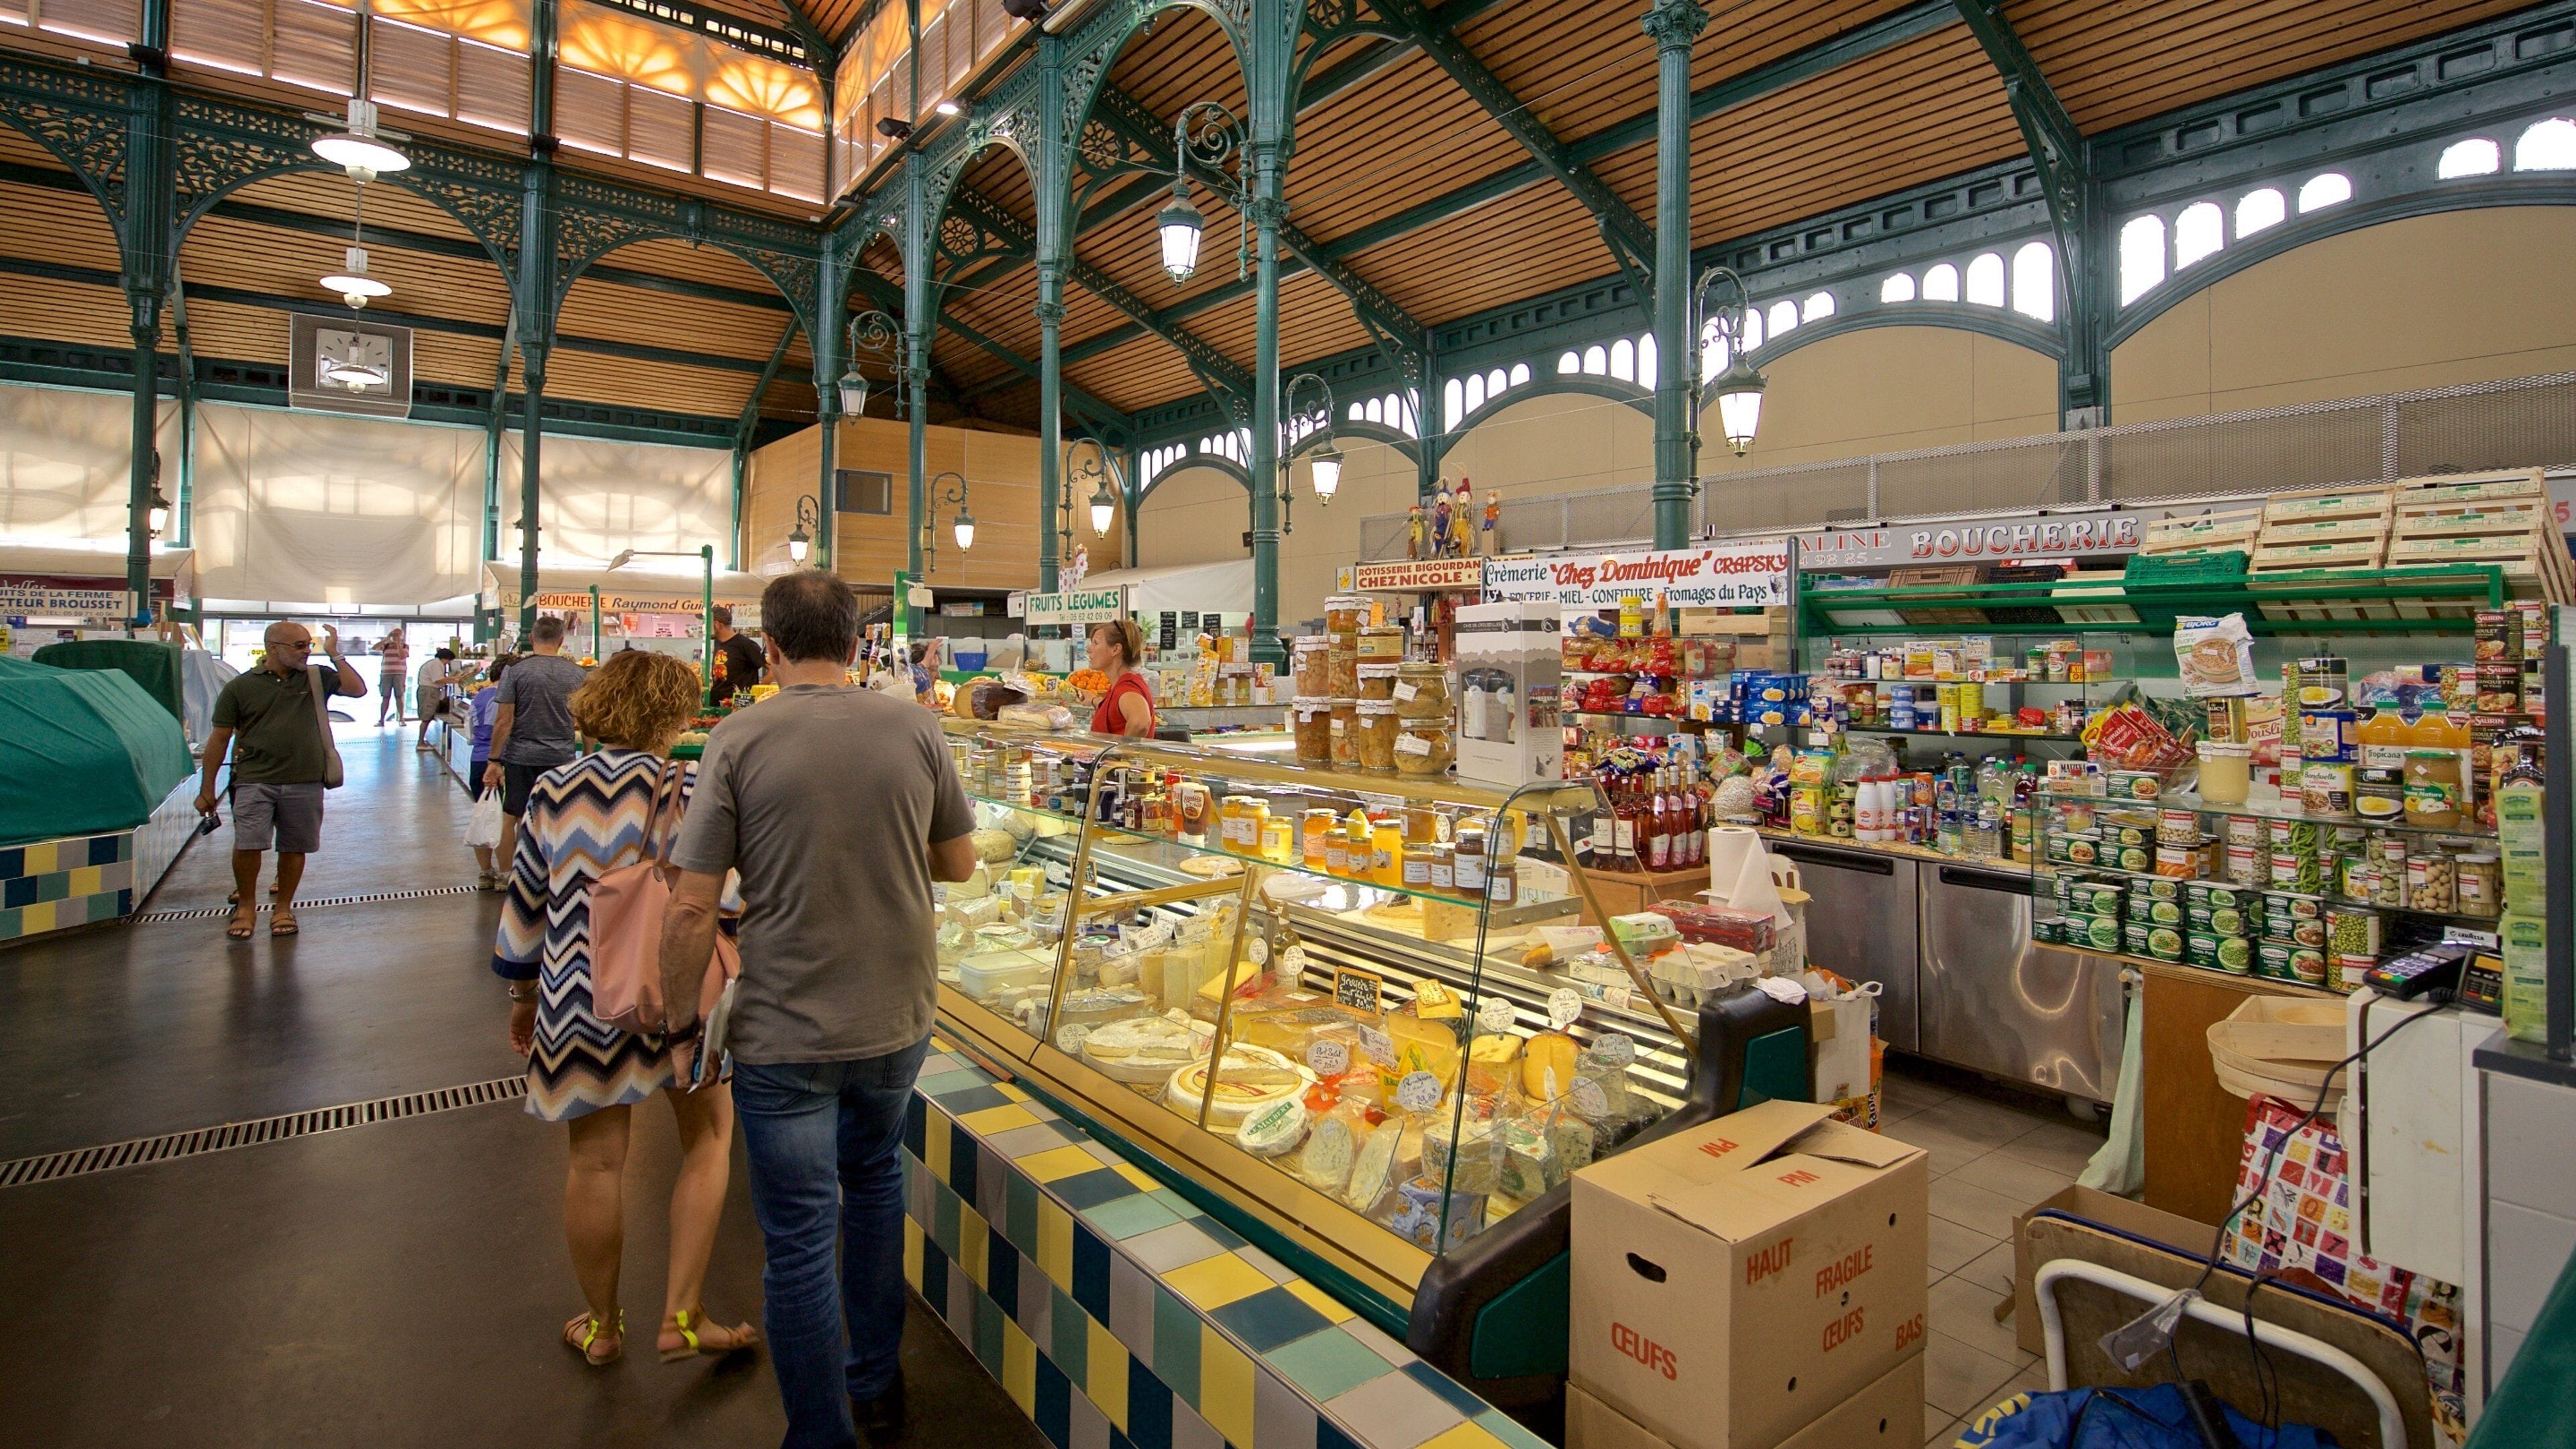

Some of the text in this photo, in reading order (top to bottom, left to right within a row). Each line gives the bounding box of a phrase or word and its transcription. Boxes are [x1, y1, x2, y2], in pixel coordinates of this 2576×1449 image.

[1911, 517, 2140, 558] BOUCHERIE
[1358, 559, 1481, 577] RÔTISSERIE BIGOURDAN
[1815, 554, 1838, 566] 98
[1845, 552, 1867, 564] 85
[1358, 577, 1397, 588] CHEZ
[1399, 572, 1462, 586] NICOLE
[1485, 562, 1548, 586] Crèmerie
[50, 599, 123, 609] BROUSSET
[612, 597, 678, 611] Raymond
[1030, 591, 1119, 612] FRUITS LEGUMES
[1559, 590, 1584, 604] MIEL
[1592, 587, 1654, 604] CONFITURE
[1664, 586, 1715, 605] Fromages
[1719, 584, 1735, 600] du
[1738, 584, 1768, 604] Pays
[2368, 749, 2401, 759] Tropicana
[2304, 771, 2337, 781] Bonduelle
[2157, 852, 2183, 861] Carottes
[1256, 1104, 1290, 1130] MAUBERT
[1698, 1137, 1741, 1158] PM
[1777, 1170, 1821, 1187] PM
[1746, 1238, 1793, 1285] HAUT
[1815, 1244, 1874, 1299] FRAGILE
[1822, 1306, 1864, 1352] ŒUFS
[1895, 1313, 1923, 1352] BAS
[1611, 1322, 1678, 1381] ŒUFS
